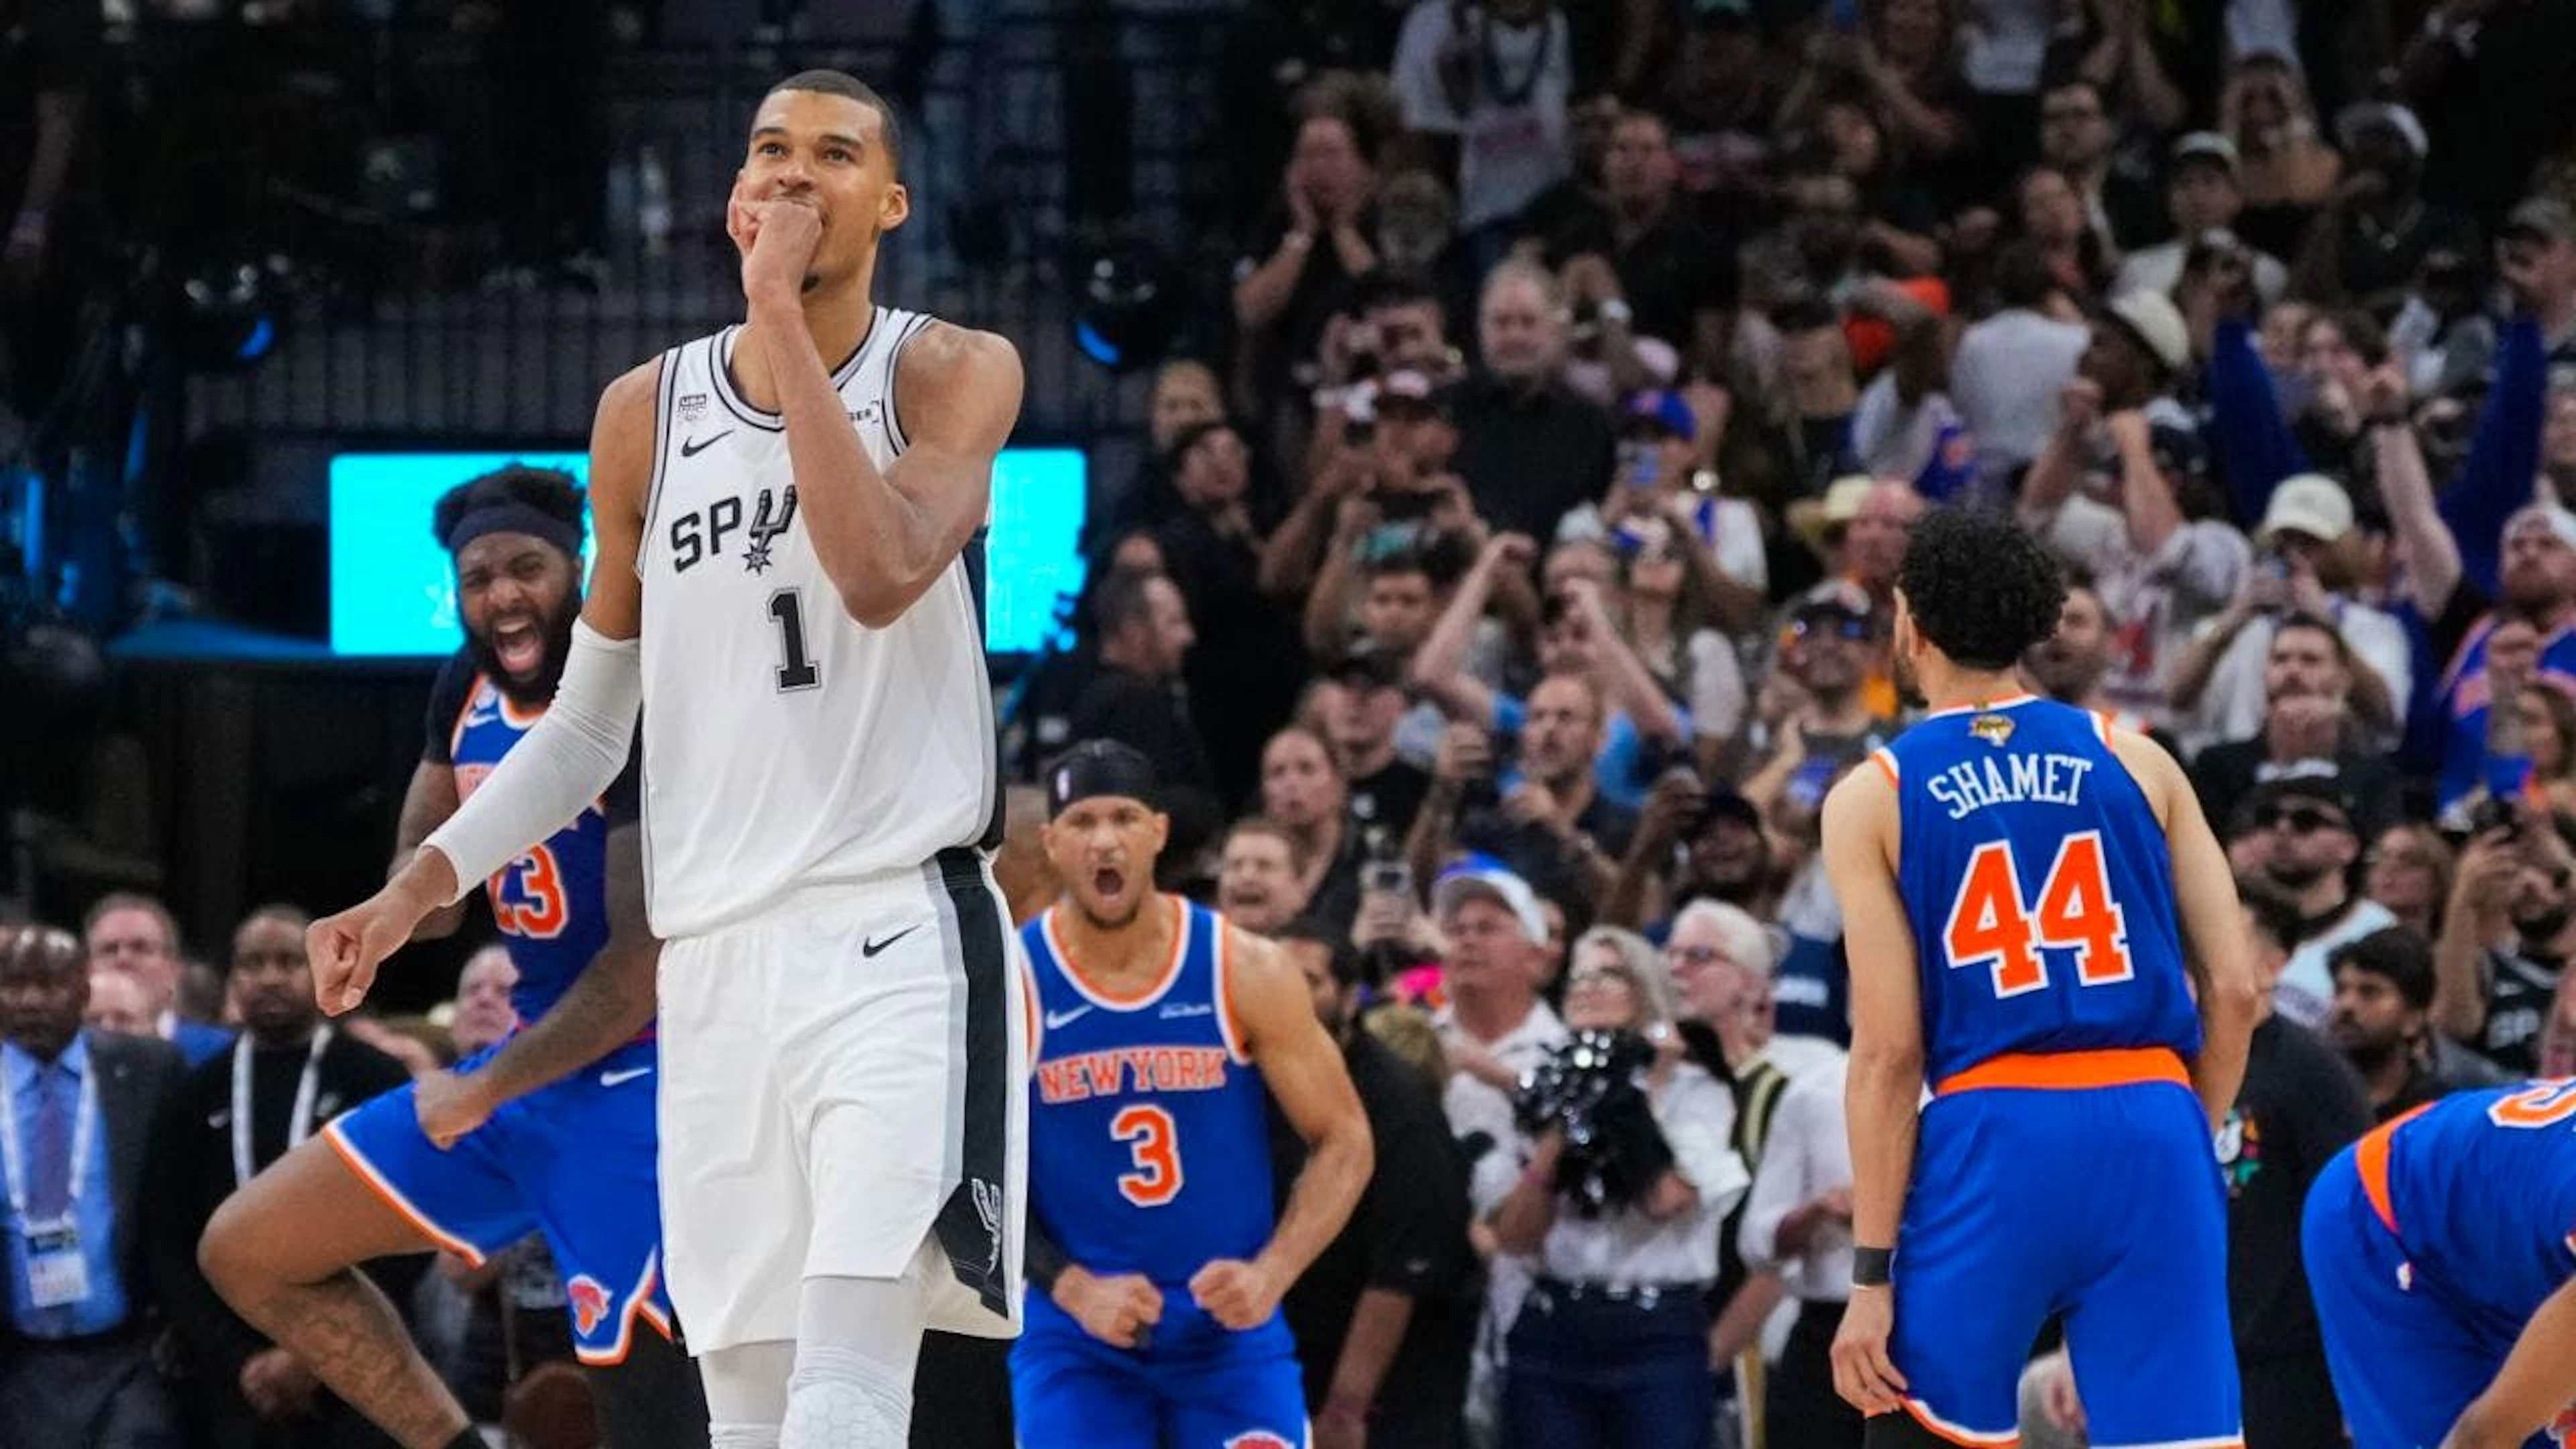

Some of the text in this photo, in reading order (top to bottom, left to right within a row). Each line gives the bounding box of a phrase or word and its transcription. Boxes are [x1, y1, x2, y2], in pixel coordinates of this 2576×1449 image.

[767, 586, 821, 694] 1
[1927, 753, 2092, 820] SHAMET
[1943, 829, 2135, 1000] 44
[1039, 1045, 1227, 1104] NEW YORK
[1110, 1104, 1183, 1208] 3
